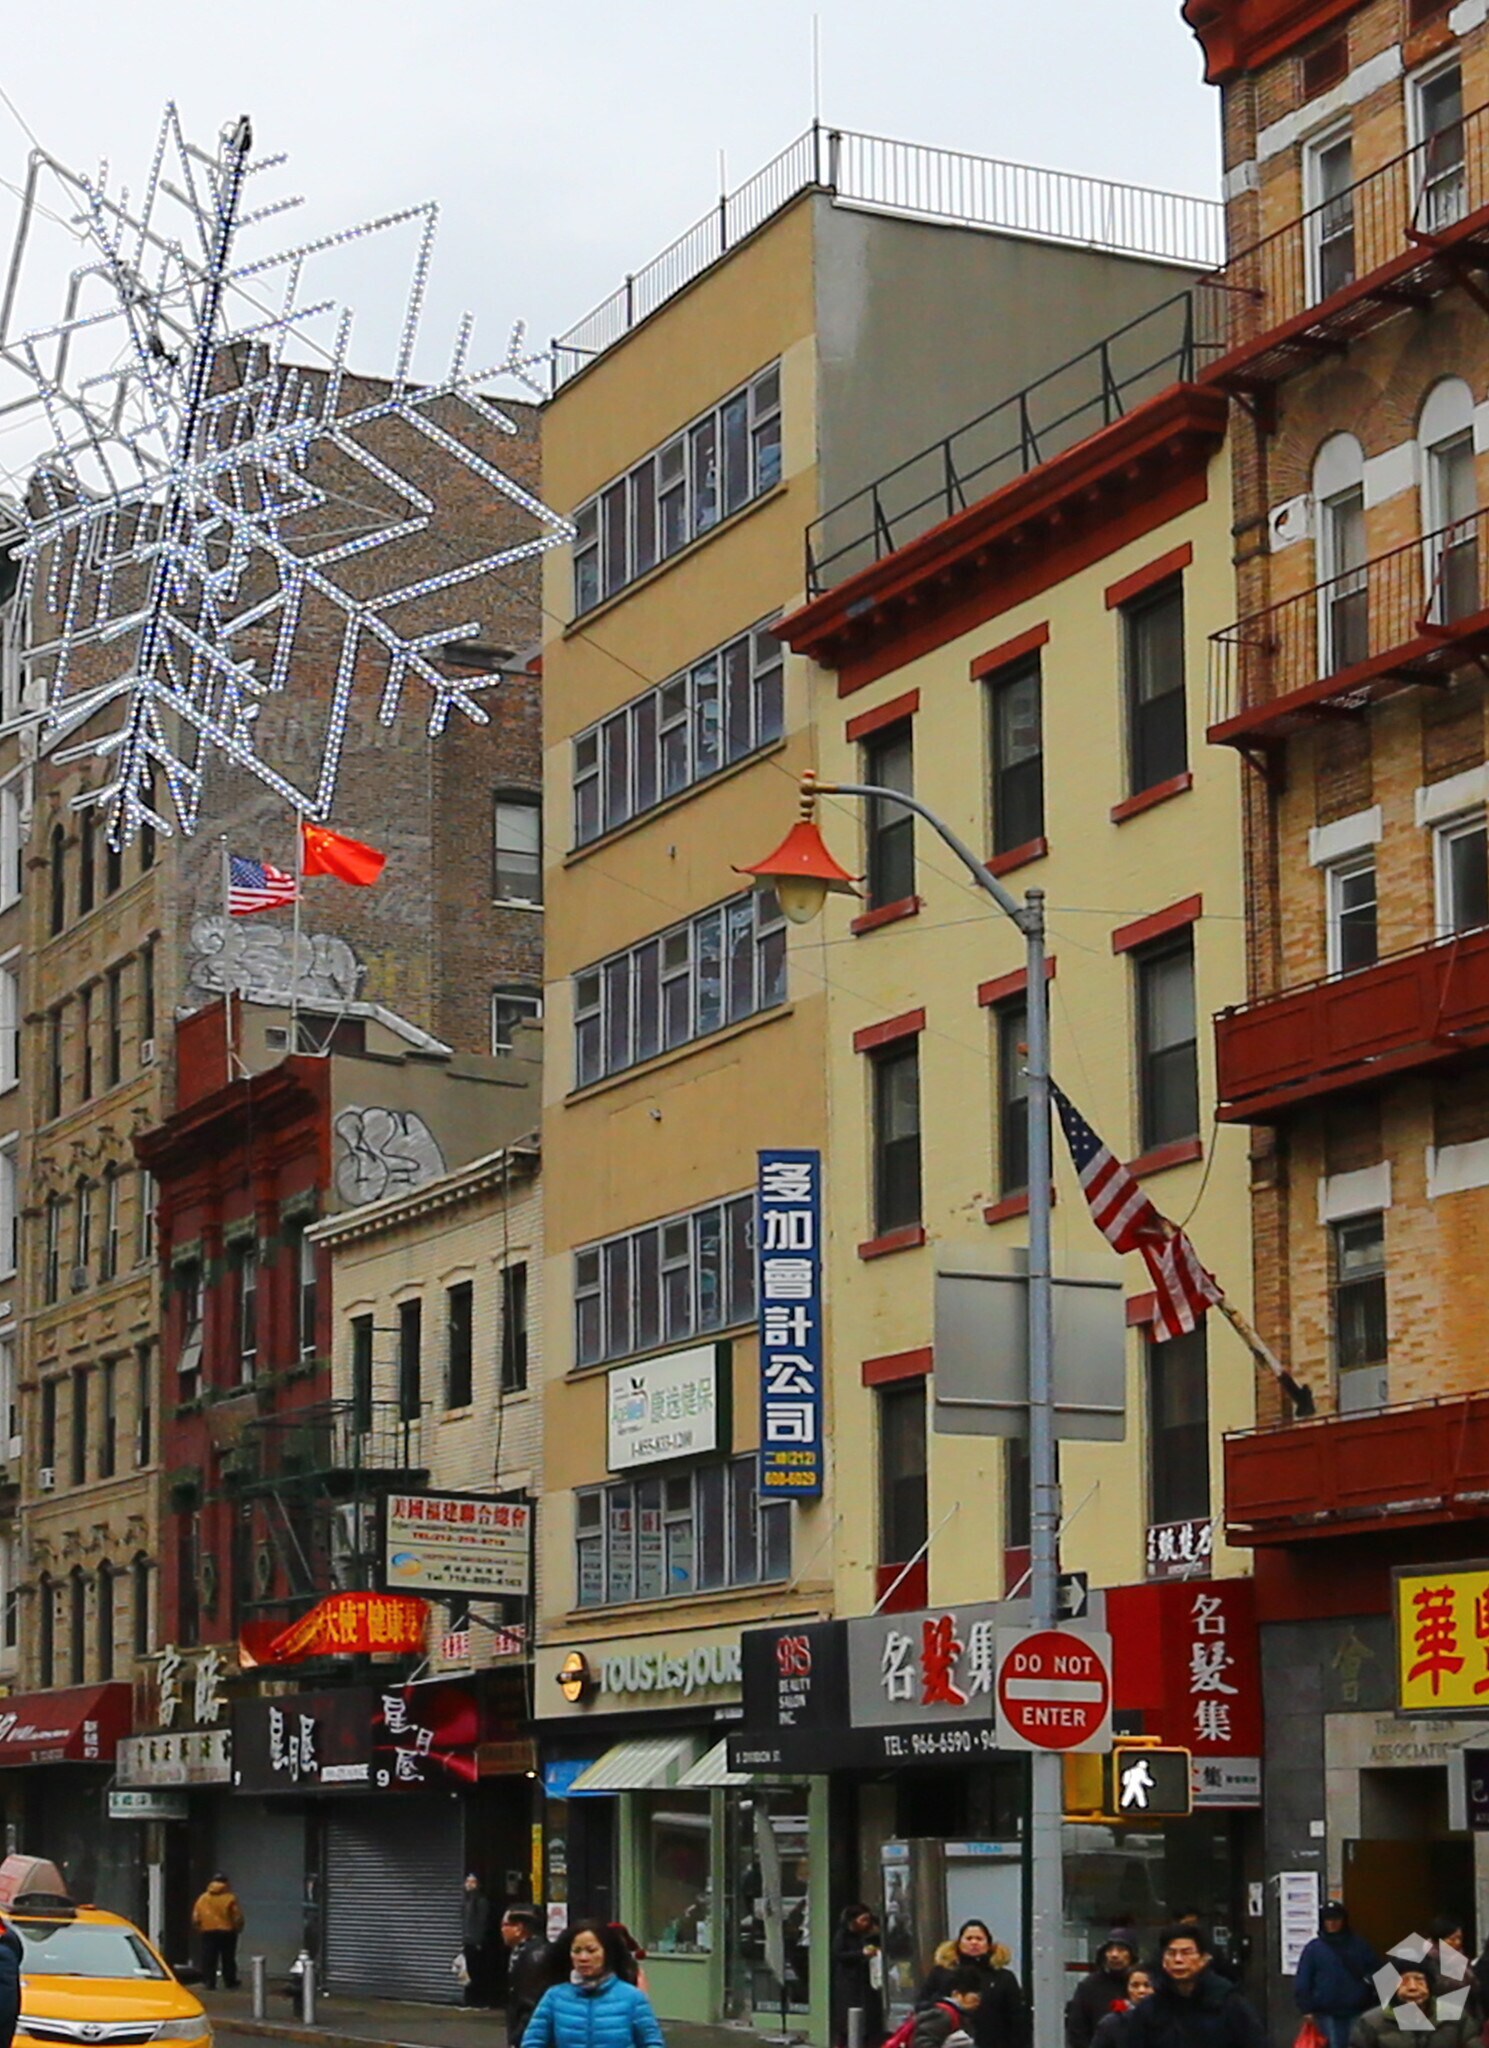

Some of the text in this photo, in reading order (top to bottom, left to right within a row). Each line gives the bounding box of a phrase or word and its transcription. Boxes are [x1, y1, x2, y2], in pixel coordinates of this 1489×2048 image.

[880, 1613, 994, 1708] 名髮集
[1014, 1653, 1092, 1675] DO NOT
[1189, 1593, 1239, 1741] 名髮集
[601, 1653, 656, 1693] TOUS
[779, 1694, 806, 1709] SALON
[1021, 1706, 1086, 1727] ENTER
[884, 1735, 908, 1756] TEL:
[911, 1730, 971, 1755] 966-6590
[376, 1769, 390, 1788] 9
